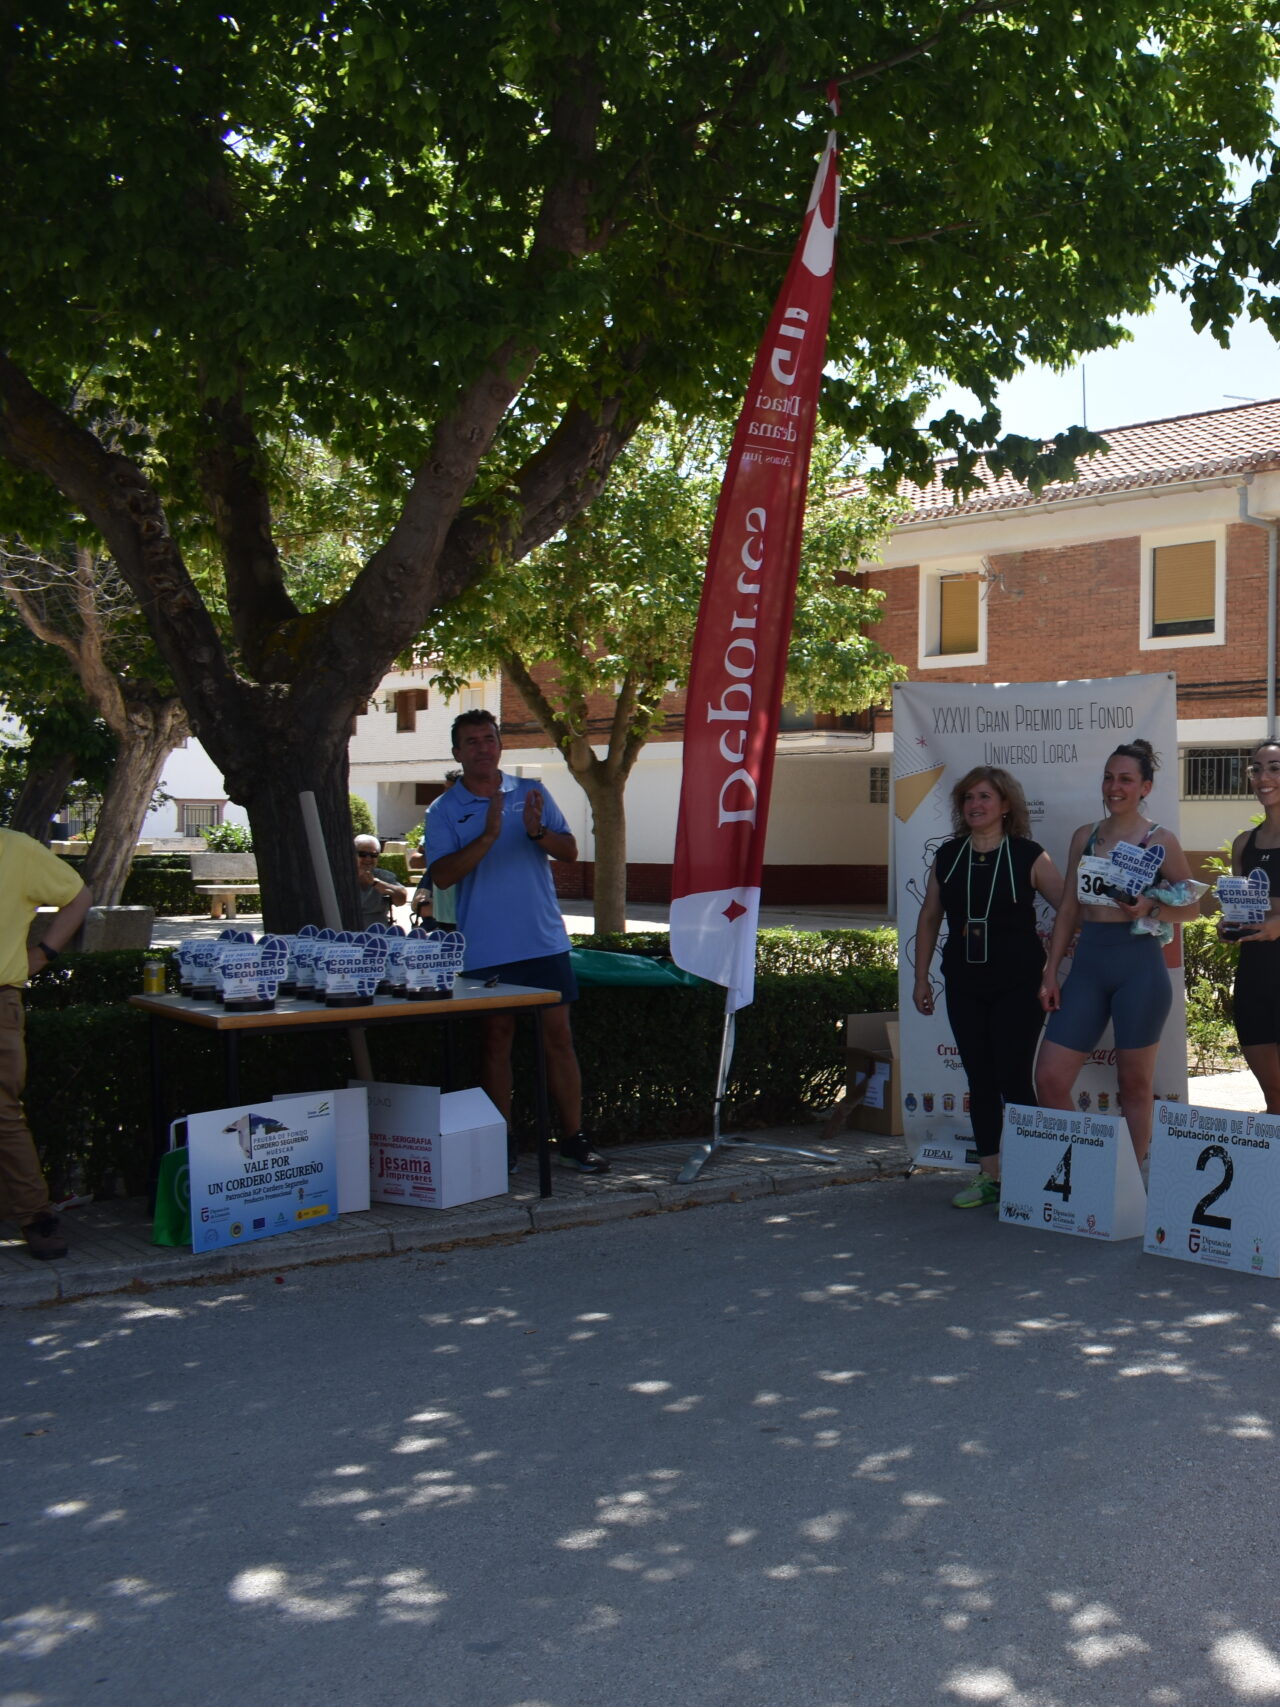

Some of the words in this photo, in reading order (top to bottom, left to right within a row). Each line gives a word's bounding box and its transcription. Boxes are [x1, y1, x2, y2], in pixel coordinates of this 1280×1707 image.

[933, 707, 971, 734] XXXVI
[976, 705, 1010, 732] GRAN
[1016, 704, 1062, 732] PREMIO
[1068, 708, 1084, 730] DE
[1090, 702, 1134, 729] FONDO
[984, 742, 1038, 765] UNIVERSO
[1042, 741, 1078, 764] LORCA
[1116, 852, 1157, 871] CORDERO
[1114, 859, 1154, 880] SEGUREÑO
[1222, 888, 1266, 898] CORDERO
[1223, 896, 1269, 906] SEGUREÑO
[331, 958, 384, 966] CORDERO
[410, 952, 462, 962] CORDERO
[227, 960, 284, 970] CORDERO
[330, 965, 384, 974] SEGUREÑO
[410, 960, 462, 970] SEGUREÑO
[227, 968, 285, 979] SEGUREÑO
[1009, 1107, 1034, 1127] GRAN
[1036, 1110, 1070, 1132] PREMIO
[1071, 1120, 1081, 1134] DE
[1084, 1116, 1114, 1138] FONDO
[1159, 1106, 1188, 1128] GRAN
[1190, 1110, 1228, 1132] PREMIO
[1230, 1120, 1243, 1134] DE
[253, 1134, 276, 1144] PRUEBA
[287, 1130, 308, 1138] FONDO
[254, 1140, 280, 1150] CORDERO
[280, 1135, 309, 1146] SEGUREÑO
[392, 1136, 432, 1146] SERIGRAFIA
[1016, 1126, 1058, 1141] Diputación
[1059, 1133, 1070, 1142] de
[1071, 1134, 1104, 1148] Granada
[1168, 1126, 1216, 1143] Diputación
[1218, 1134, 1230, 1144] de
[1232, 1135, 1270, 1150] Granada
[922, 1149, 953, 1160] IDEAL
[244, 1159, 269, 1174] VALE
[272, 1156, 290, 1169] POR
[378, 1148, 432, 1178] jesama
[208, 1183, 223, 1195] UN
[226, 1172, 272, 1192] CORDERO
[275, 1160, 324, 1182] SEGUREÑO
[386, 1171, 432, 1183] impresores
[1043, 1142, 1072, 1202] 4
[226, 1190, 252, 1201] Patrocina
[252, 1188, 262, 1196] IGP
[262, 1184, 284, 1194] Cordero
[1192, 1144, 1234, 1230] 2
[1202, 1236, 1232, 1248] Diputación
[1208, 1246, 1232, 1257] Granada
